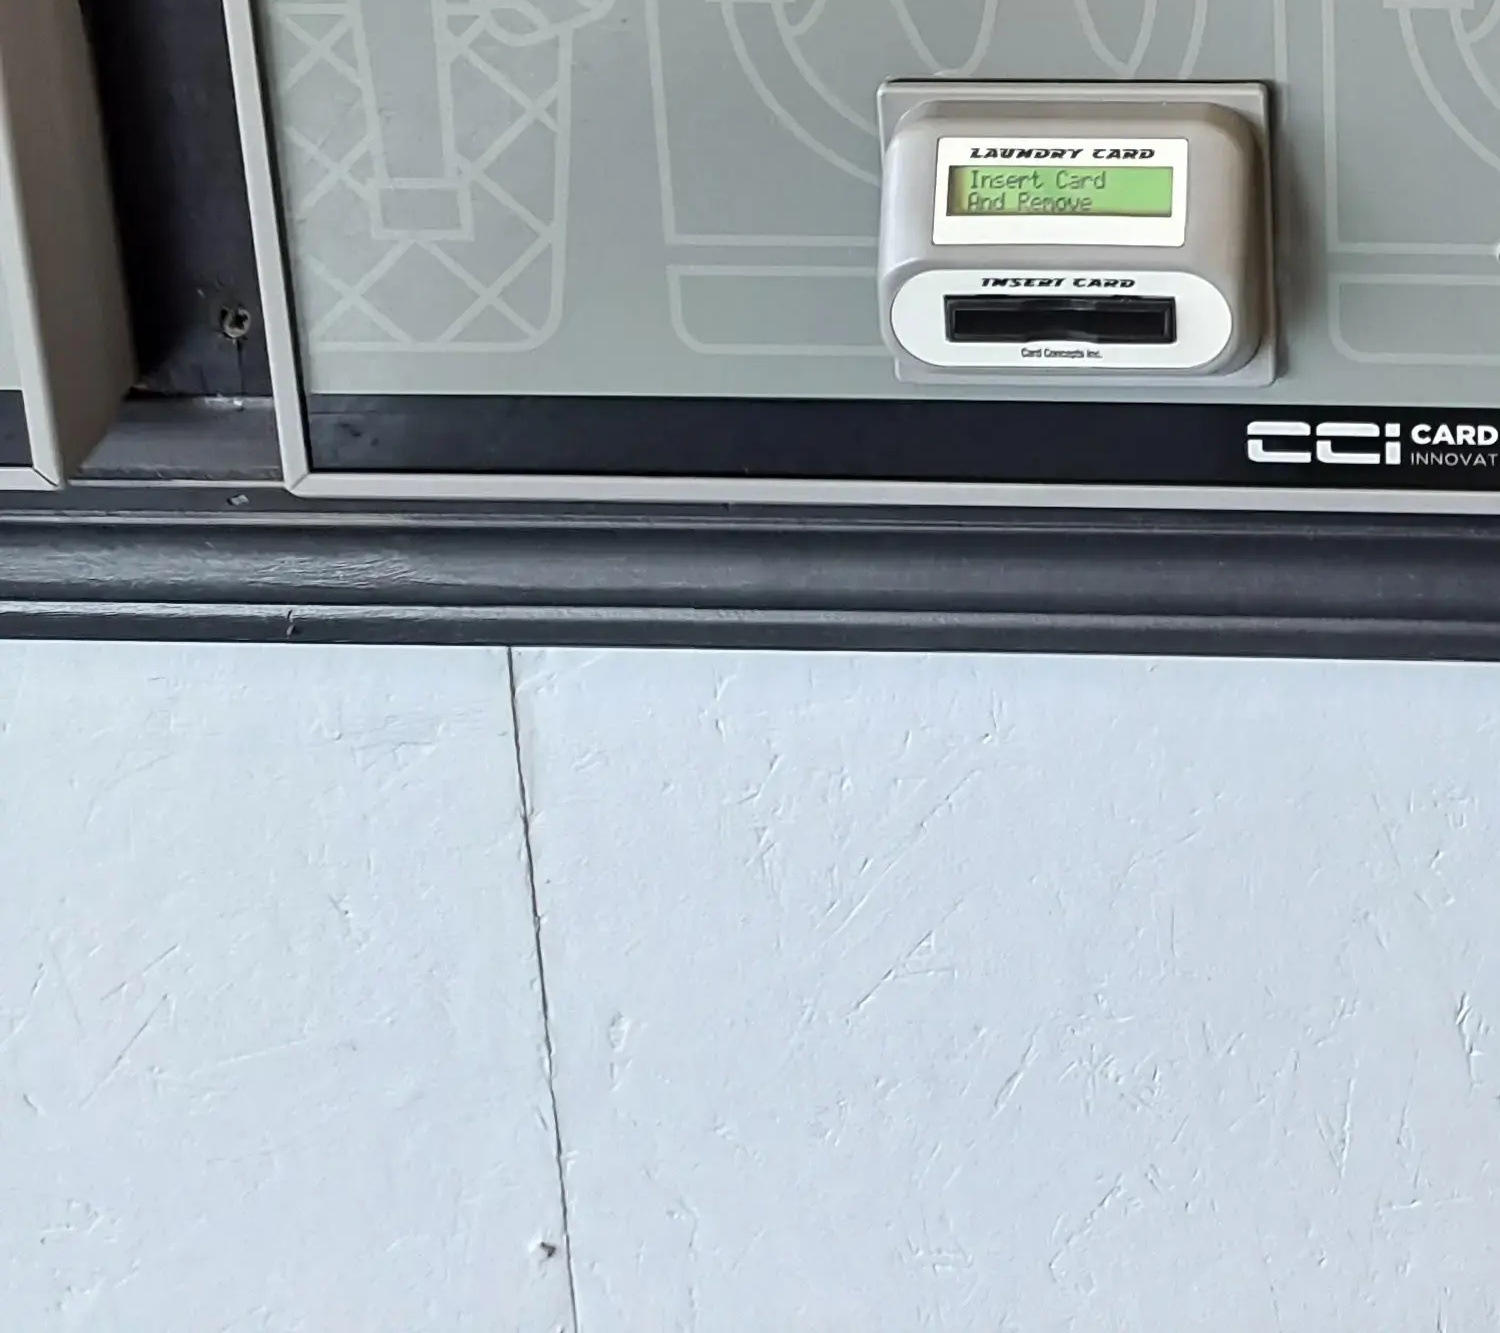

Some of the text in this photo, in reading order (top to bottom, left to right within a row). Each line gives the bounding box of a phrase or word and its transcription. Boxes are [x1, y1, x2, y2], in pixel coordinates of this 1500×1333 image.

[970, 147, 1155, 160] LAUNDRY CARD
[970, 169, 1106, 190] Insert Card
[967, 192, 1093, 212] And Remove
[981, 277, 1136, 288] INSERT CARD
[1411, 423, 1499, 446] CARD
